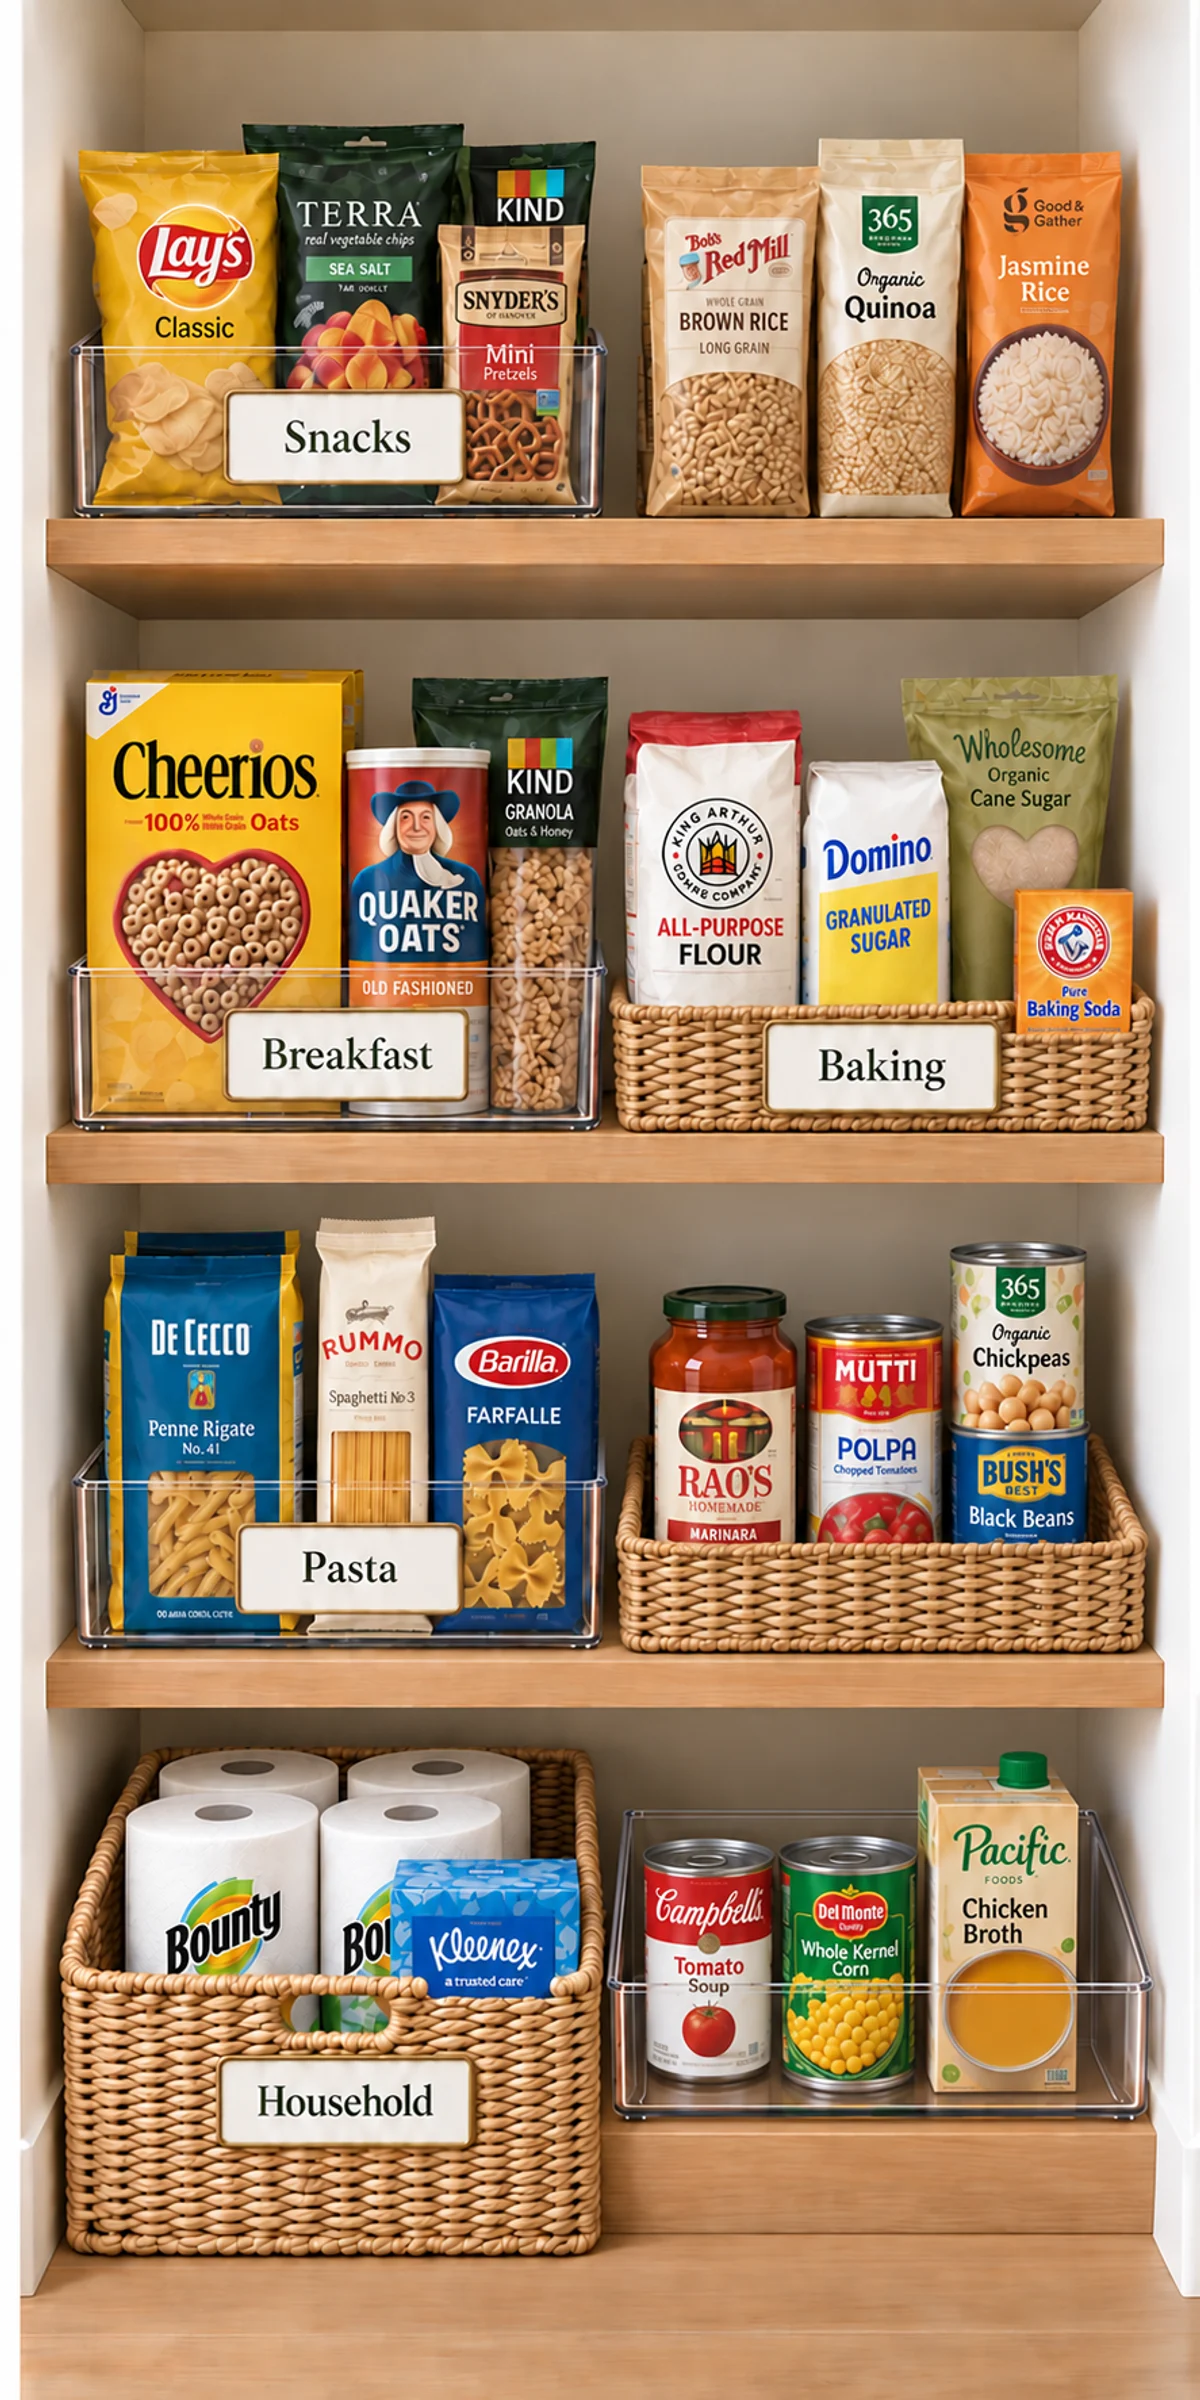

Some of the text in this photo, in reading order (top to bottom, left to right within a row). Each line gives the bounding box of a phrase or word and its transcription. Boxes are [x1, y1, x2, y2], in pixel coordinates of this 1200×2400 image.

[296, 201, 422, 227] TERRA
[496, 198, 565, 222] KIND
[1033, 199, 1084, 212] Good &
[868, 204, 913, 233] 365
[1034, 214, 1082, 227] Gather
[305, 232, 415, 248] real vegetable chips
[685, 232, 722, 252] Bob's
[148, 227, 245, 287] Lay's
[703, 233, 790, 285] Red Mill
[998, 255, 1090, 280] Jasmine
[329, 263, 391, 276] SEA SALT
[857, 267, 925, 294] Organic
[463, 290, 559, 313] SNYDER'S
[705, 297, 764, 307] WHOLE GRAIN
[1021, 281, 1070, 302] Rice
[845, 295, 936, 323] Quinoa
[155, 316, 235, 338] Classic
[679, 312, 789, 331] BROWN RICE
[486, 343, 534, 364] Mini
[699, 342, 770, 355] LONG GRAIN
[484, 366, 538, 380] Pretzels
[285, 419, 412, 454] Snacks
[953, 727, 1086, 764] Wholesome
[113, 739, 318, 800] Cheerios
[988, 767, 1050, 786] Organic
[507, 769, 574, 794] KIND
[505, 803, 574, 820] GRANOLA
[970, 789, 1071, 811] Cane Sugar
[144, 813, 200, 831] 100%
[250, 813, 300, 832] Oats
[505, 826, 527, 837] Oats
[540, 826, 574, 839] Honey
[672, 807, 764, 848] KING ARTHUR
[823, 833, 932, 880] Domino
[358, 889, 478, 927] QUAKER
[826, 898, 931, 931] GRANULATED
[378, 923, 461, 953] OATS
[657, 918, 784, 938] ALL-PURPOSE
[850, 927, 911, 954] SUGAR
[679, 943, 762, 965] FLOUR
[362, 980, 474, 996] OLD FASHIONED
[1062, 985, 1087, 997] Pure
[1027, 1000, 1120, 1022] Baking Soda
[262, 1036, 433, 1071] Breakfast
[818, 1048, 946, 1091] Baking
[1001, 1274, 1040, 1300] 365
[152, 1319, 250, 1355] DE CECCO
[322, 1331, 423, 1360] RUMMO
[992, 1323, 1051, 1348] Organic
[478, 1349, 557, 1373] Barilla
[835, 1359, 916, 1382] MUTTI
[973, 1347, 1070, 1374] Chickpeas
[329, 1389, 387, 1408] Spaghetti
[467, 1406, 561, 1424] FARFALLE
[149, 1420, 255, 1441] Penne Rigate
[183, 1443, 204, 1455] No.
[838, 1436, 916, 1461] POLPA
[678, 1464, 773, 1499] RAO'S
[833, 1464, 918, 1477] Chopped Tomatoes
[983, 1459, 1061, 1487] BUSH'S
[688, 1501, 763, 1513] HOMEMADE
[969, 1505, 1075, 1528] Black Beans
[690, 1526, 758, 1541] MARINARA
[302, 1550, 398, 1583] Pasta
[953, 1824, 1069, 1876] Pacific
[985, 1876, 1023, 1884] FOODS
[655, 1887, 764, 1936] Campbell's
[818, 1903, 884, 1920] Del Monte
[962, 1897, 1048, 1920] Chicken
[165, 1890, 281, 1975] Bounty
[963, 1923, 1023, 1944] Broth
[429, 1927, 538, 1972] Kleenex
[801, 1939, 899, 1960] Whole Kernel
[674, 1956, 744, 1976] Tomato
[832, 1961, 870, 1976] Corn
[444, 1977, 525, 1987] a trusted care
[688, 1978, 730, 1997] Soup
[258, 2083, 433, 2117] Household
